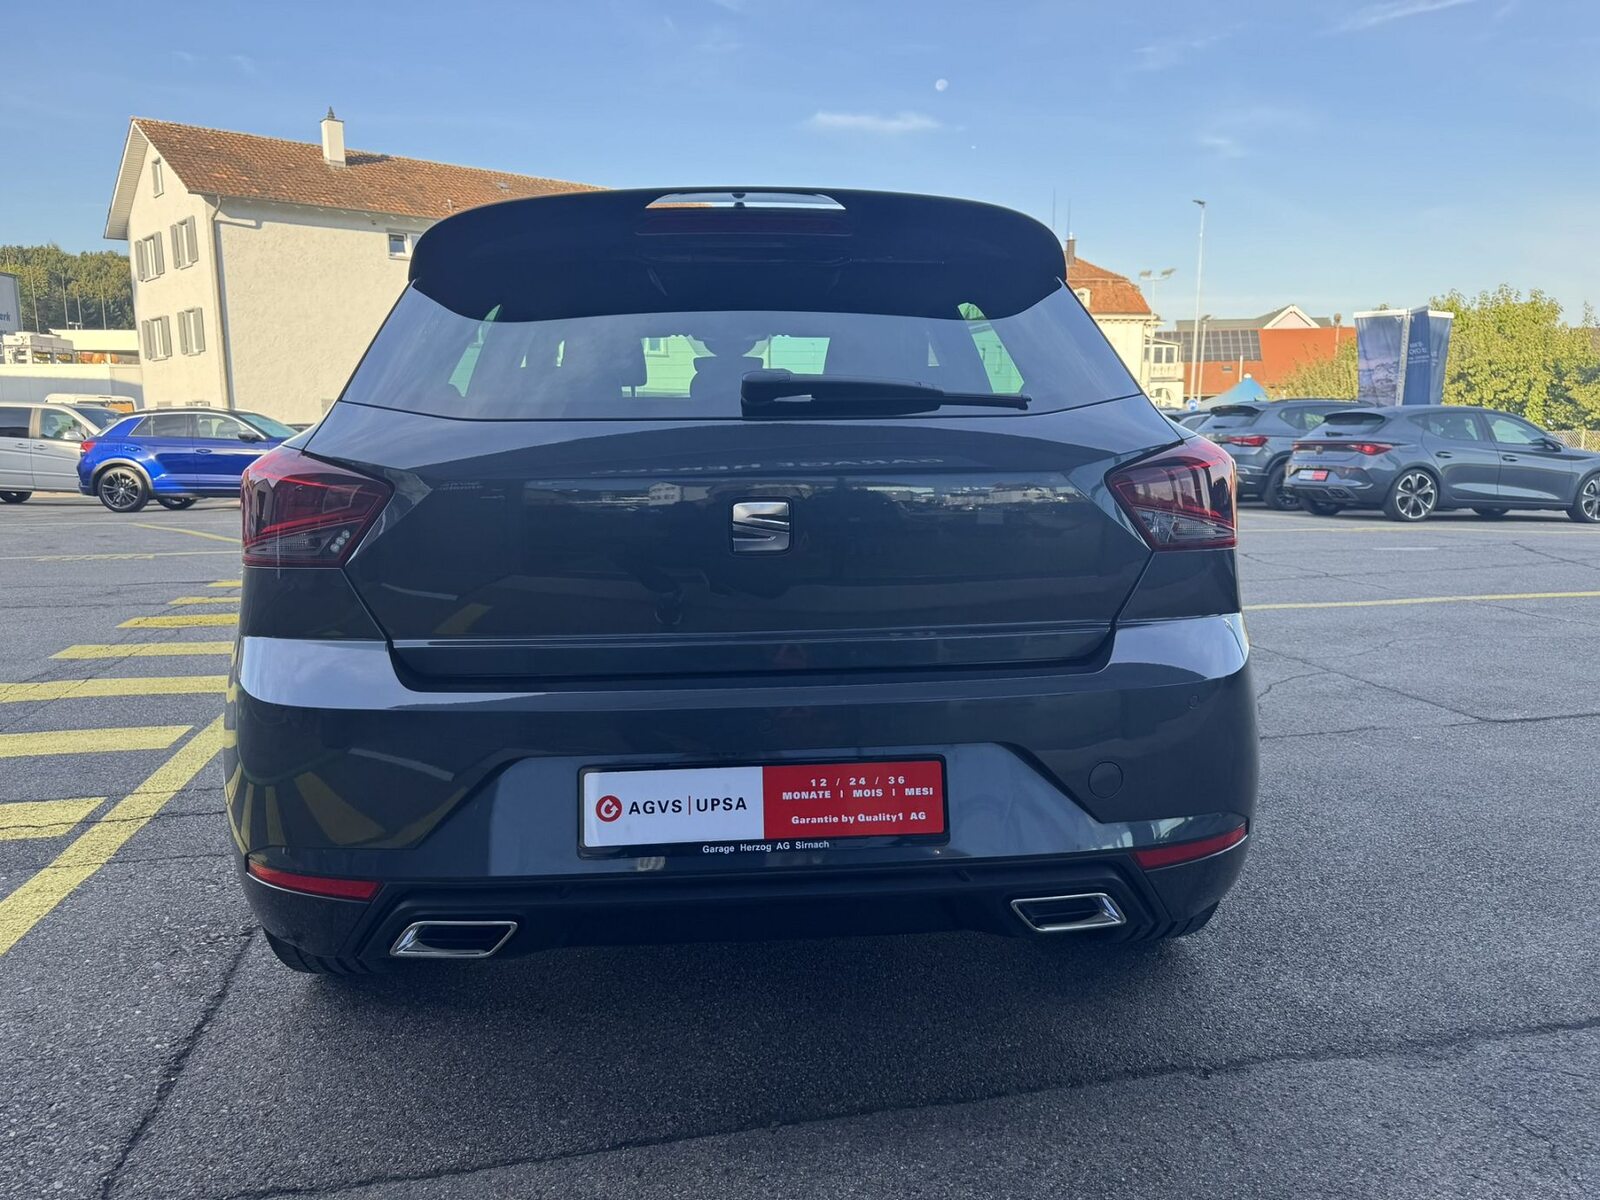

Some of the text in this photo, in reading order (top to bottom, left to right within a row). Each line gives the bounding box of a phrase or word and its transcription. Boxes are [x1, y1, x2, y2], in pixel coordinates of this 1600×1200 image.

[782, 790, 831, 800] MONATE
[852, 788, 884, 798] MOIS
[904, 787, 934, 796] MESI
[628, 797, 748, 815] AGVS UPSA
[791, 811, 927, 824] Garantie by Quality1 AG
[702, 840, 830, 854] Garage Herzog AG Sirnach
